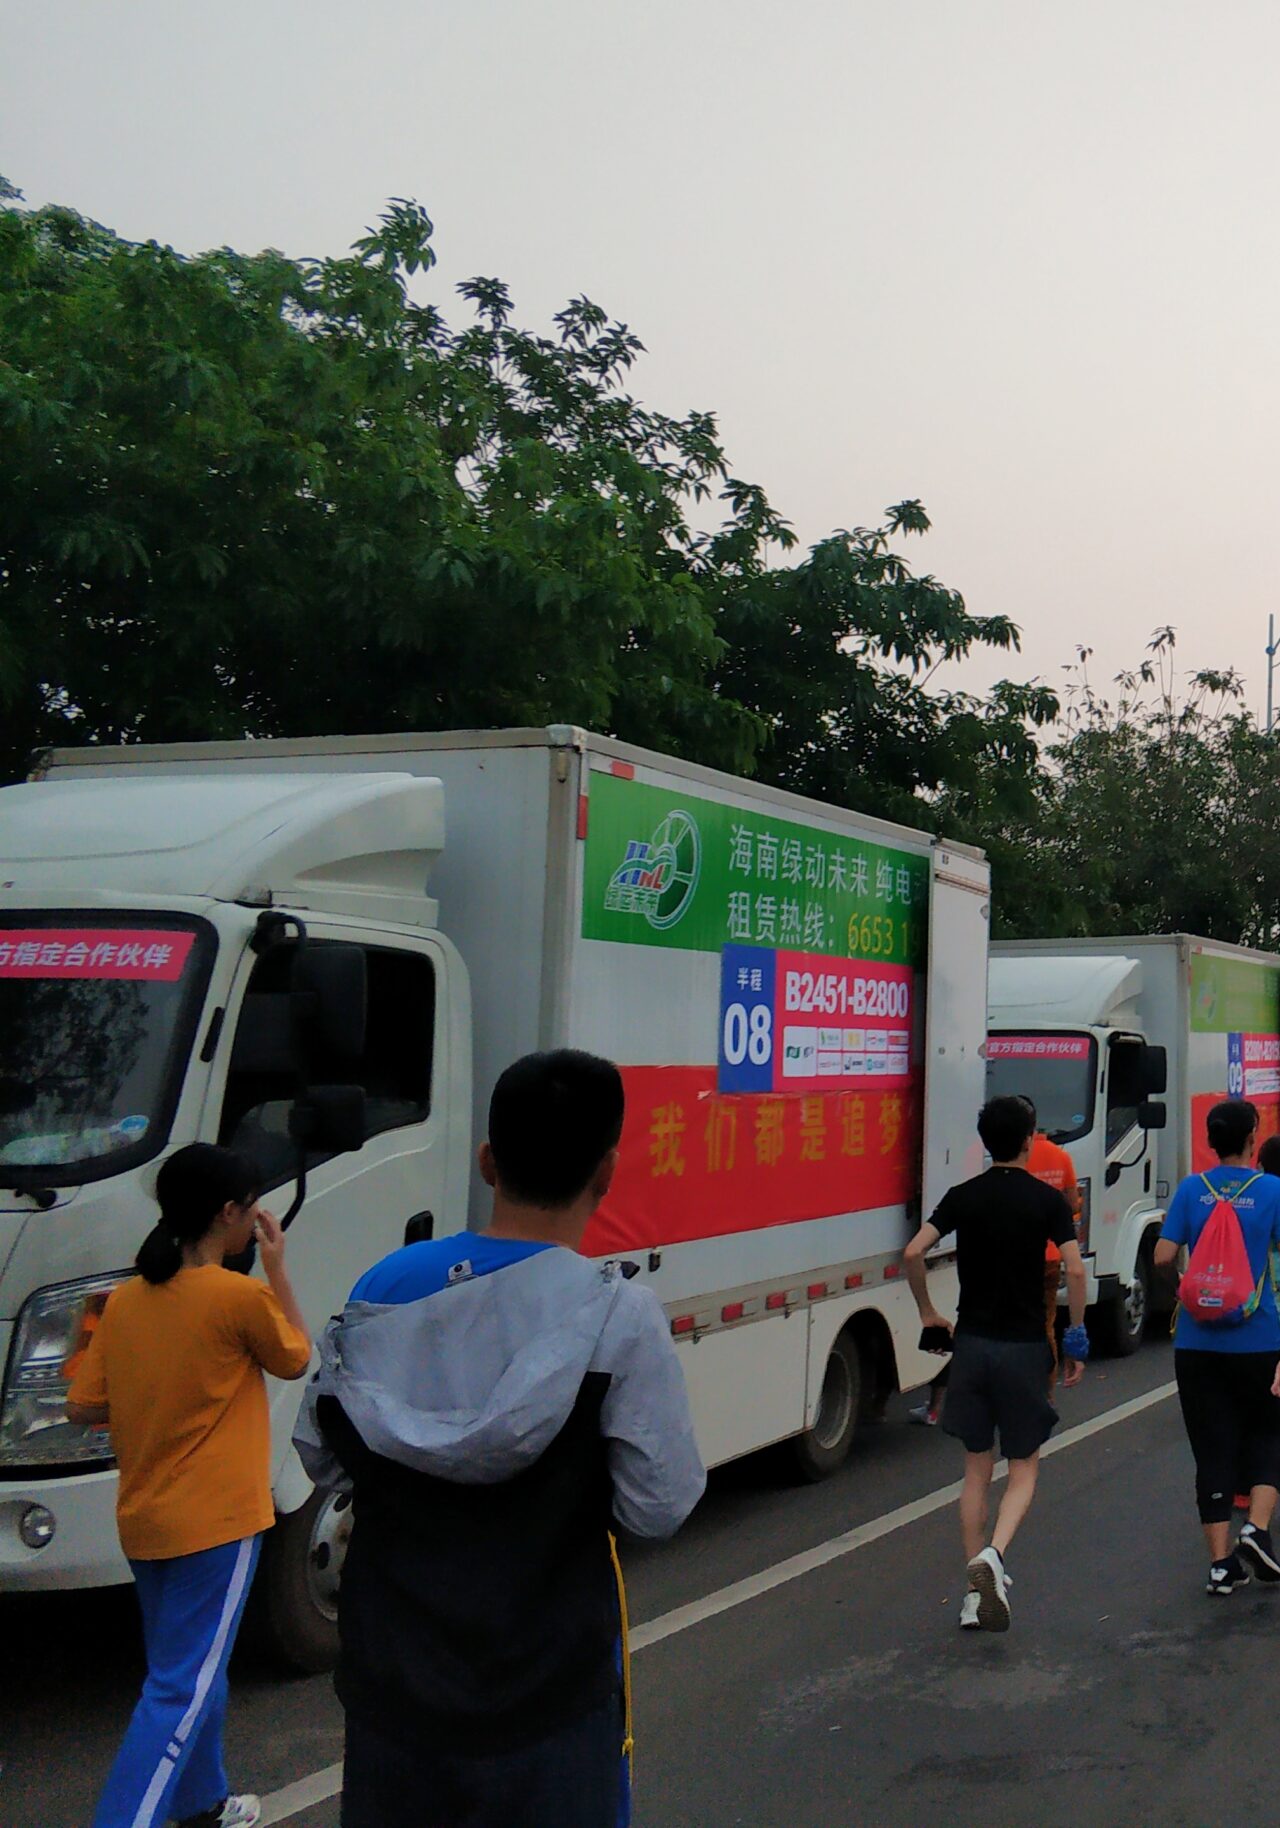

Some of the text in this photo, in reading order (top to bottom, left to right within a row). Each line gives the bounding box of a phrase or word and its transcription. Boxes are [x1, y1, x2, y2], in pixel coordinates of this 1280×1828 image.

[737, 966, 762, 992] 半程
[785, 970, 909, 1018] B2451-B2800
[724, 1002, 772, 1066] 08
[1229, 1061, 1243, 1094] 09
